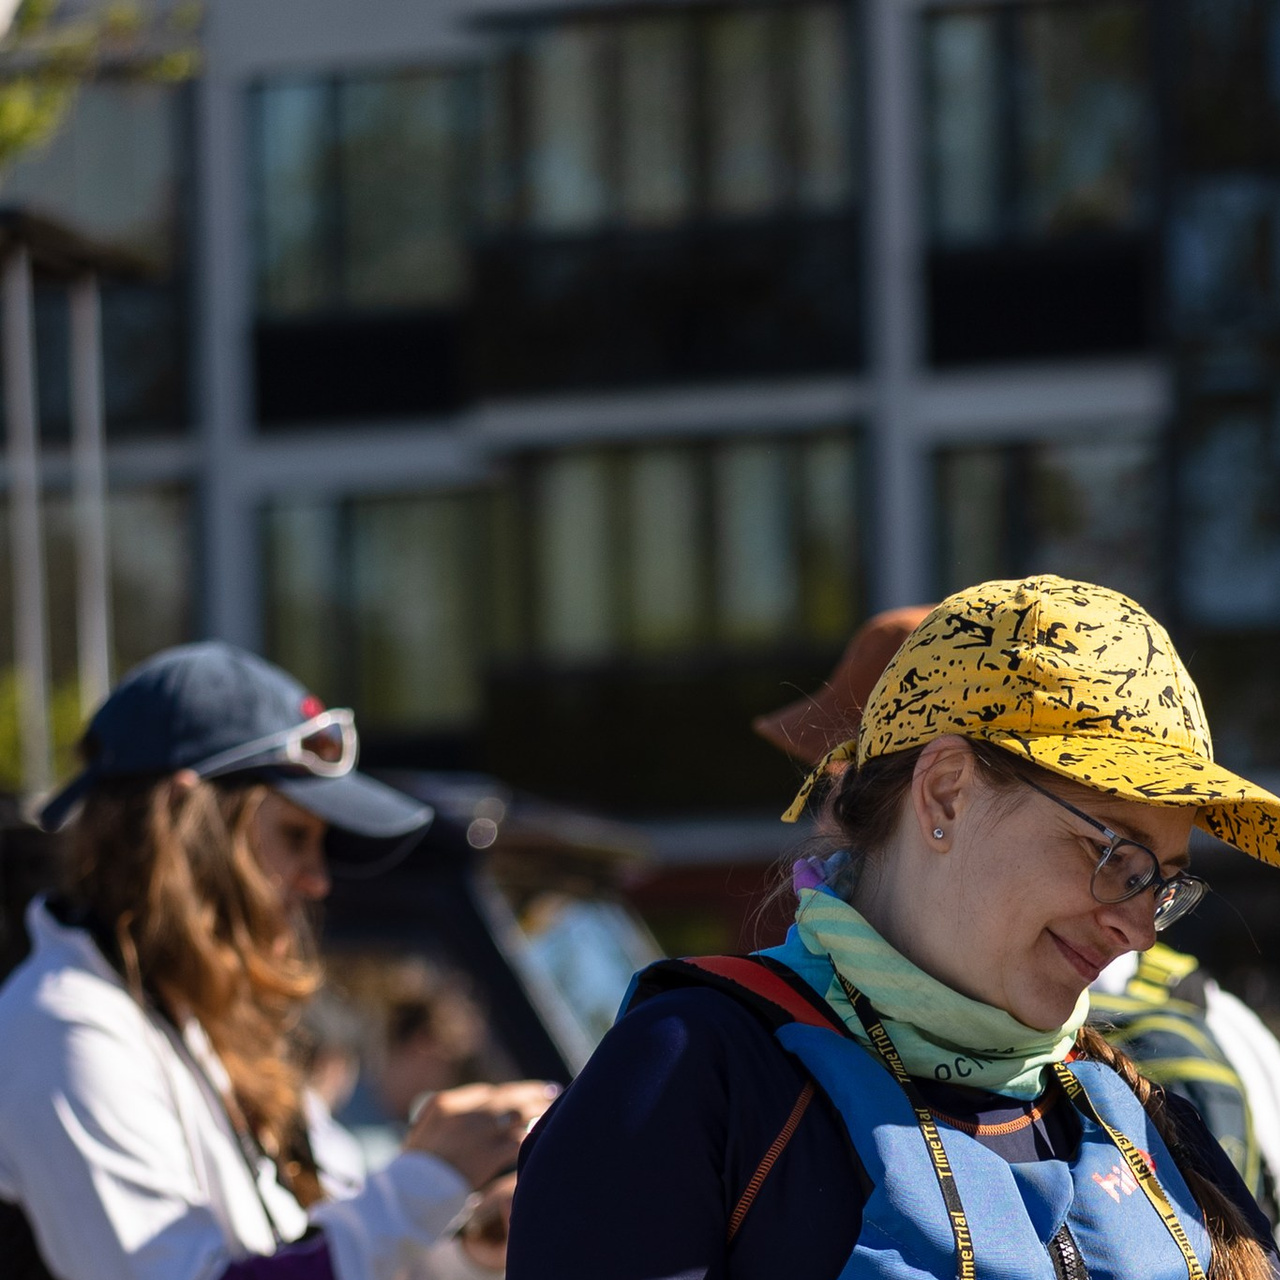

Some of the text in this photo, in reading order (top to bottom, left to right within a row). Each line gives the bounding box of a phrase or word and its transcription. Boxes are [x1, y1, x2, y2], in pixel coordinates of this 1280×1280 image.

[866, 1024, 911, 1083] TimeTrial
[1053, 1061, 1083, 1099] eTrial
[915, 1108, 952, 1179] TimeTrial
